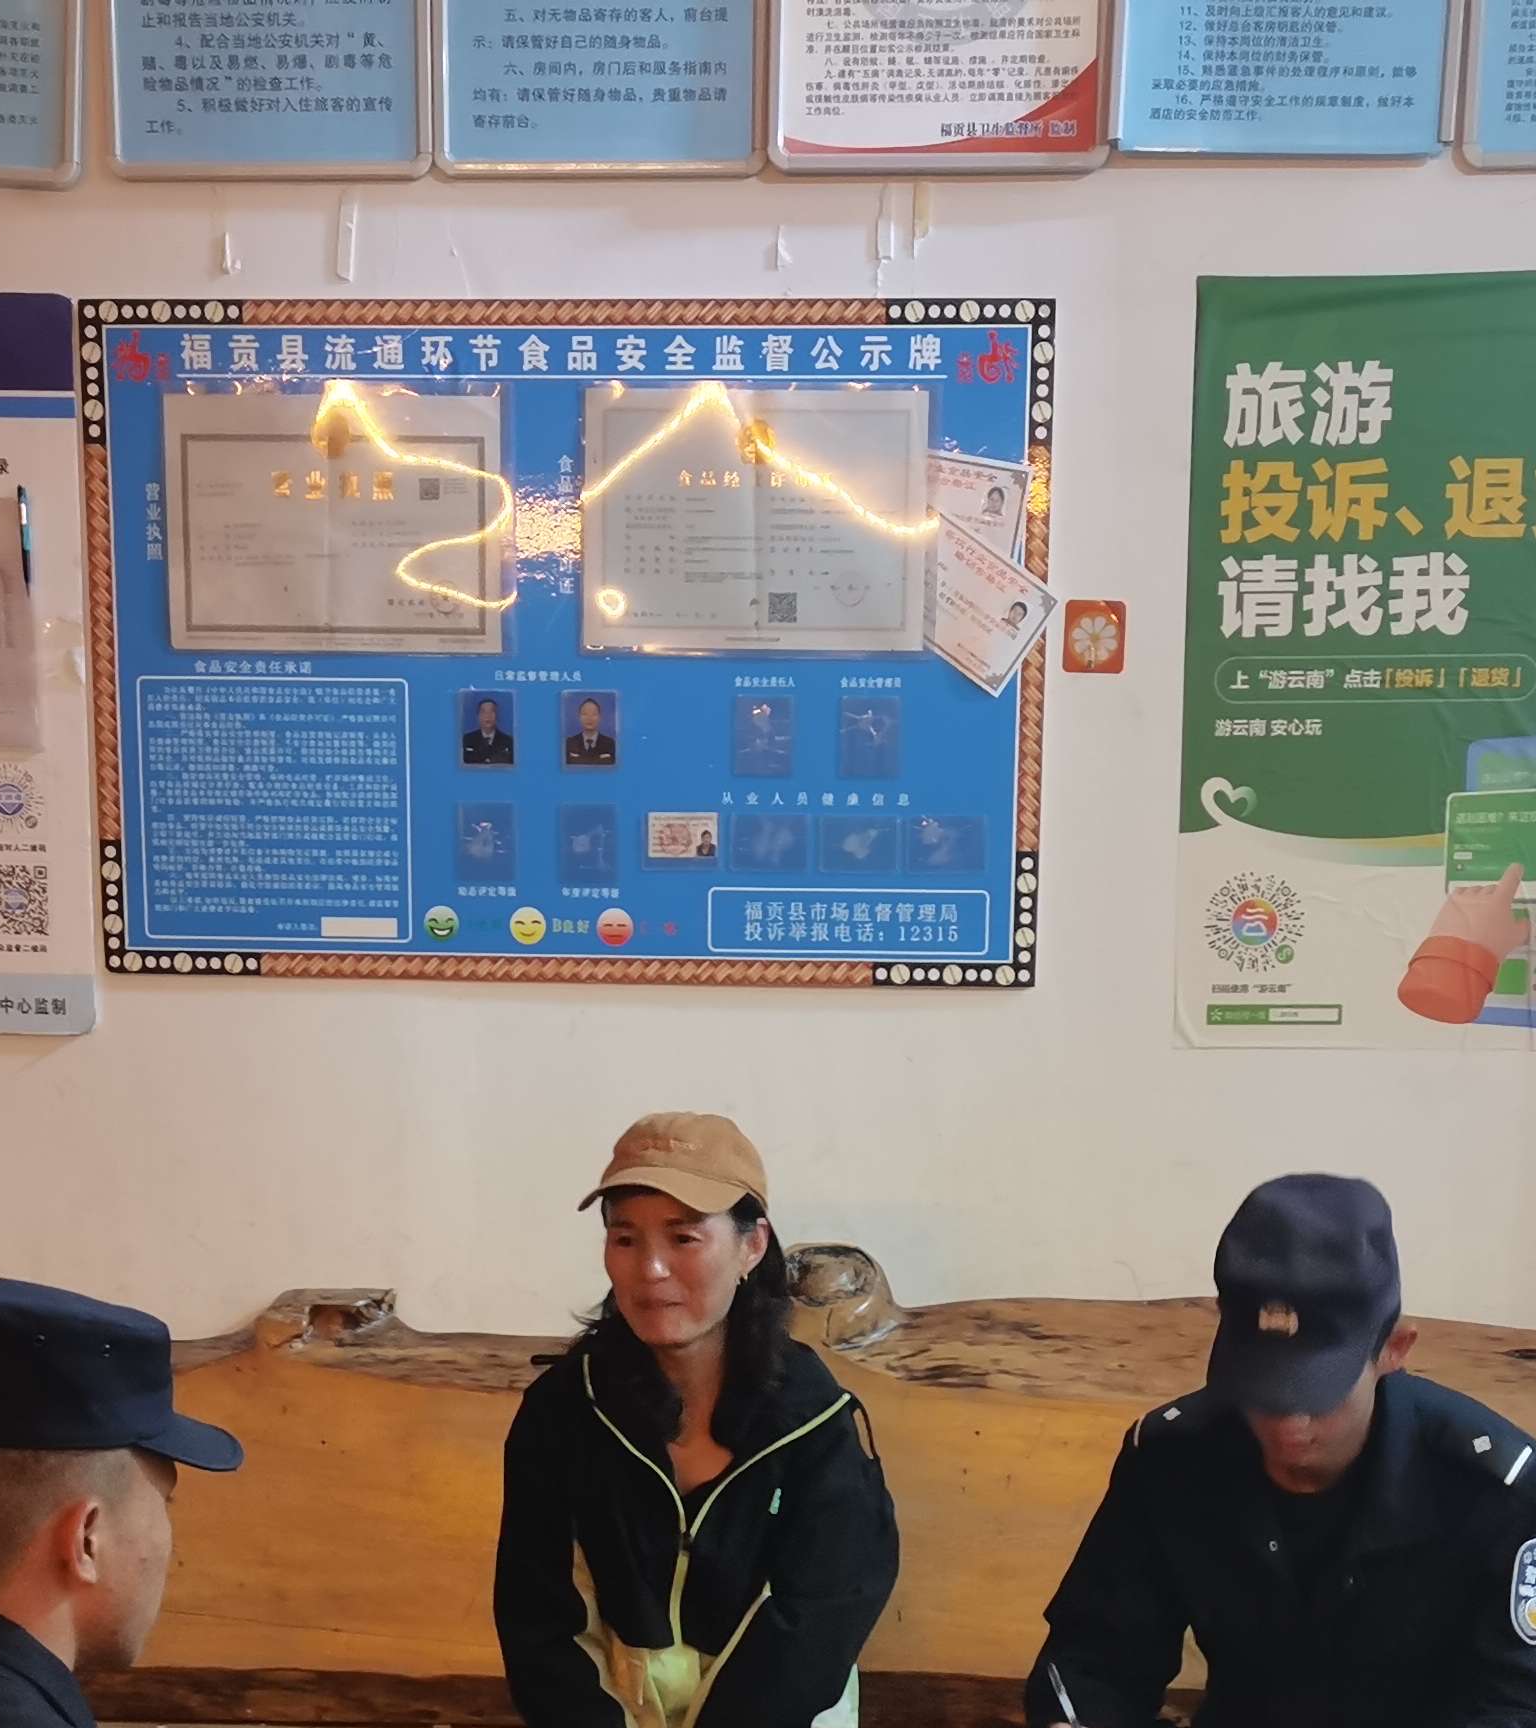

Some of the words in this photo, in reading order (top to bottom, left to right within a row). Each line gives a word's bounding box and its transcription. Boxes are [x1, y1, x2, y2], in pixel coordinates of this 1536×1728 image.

[180, 333, 943, 373] 福贡县流通环节食品安全监督公示牌
[1223, 360, 1394, 448] 旅游
[145, 482, 163, 561] 营业执照
[1219, 552, 1470, 638] 请找我
[194, 660, 313, 674] 食品安全责任承诺
[1214, 718, 1266, 738] 游云南
[1270, 718, 1322, 738] 安心玩
[744, 900, 958, 923] 福贡县市场监督管理局
[744, 922, 958, 943] 投诉举报电话：12315
